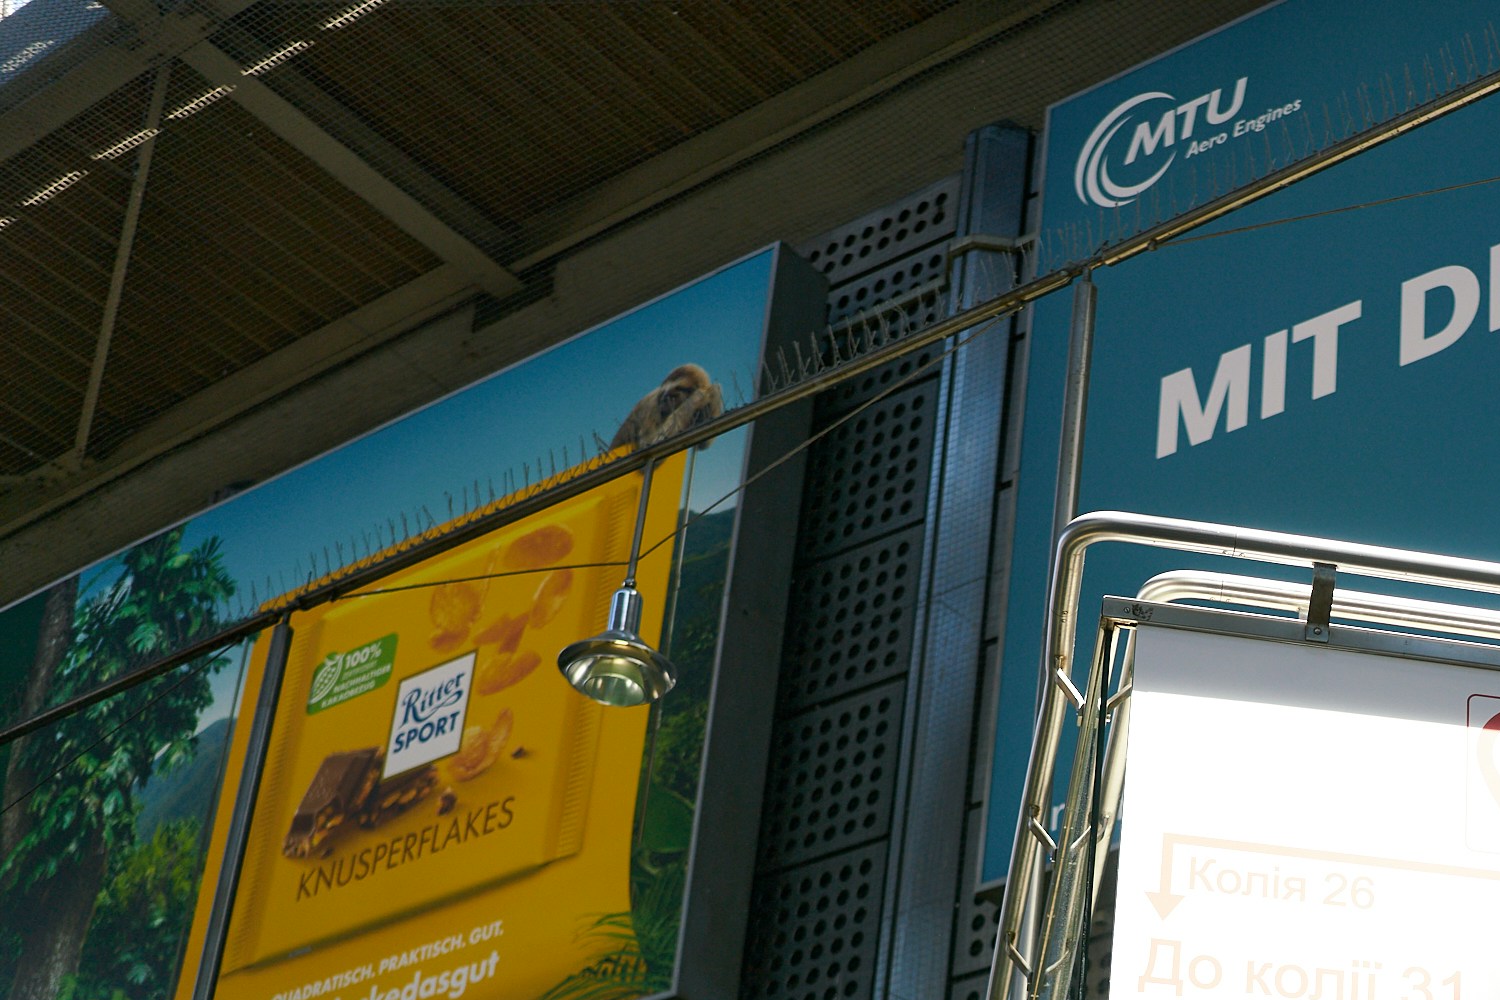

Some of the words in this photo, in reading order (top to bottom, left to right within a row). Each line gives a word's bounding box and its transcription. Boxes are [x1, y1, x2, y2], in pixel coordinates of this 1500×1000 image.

[1123, 76, 1248, 165] MTU
[1185, 132, 1228, 159] Aero
[1233, 98, 1302, 139] Engines
[1156, 300, 1362, 458] MIT
[345, 641, 382, 669] 100%
[399, 673, 465, 728] Ritter
[393, 711, 459, 753] SPORT
[296, 796, 515, 901] KNUSPERFLAKES
[1188, 856, 1307, 901] Колія
[1322, 872, 1375, 909] 26
[378, 933, 466, 975] PRAKTISCH.
[469, 920, 504, 945] GUT.
[1137, 938, 1222, 997] До
